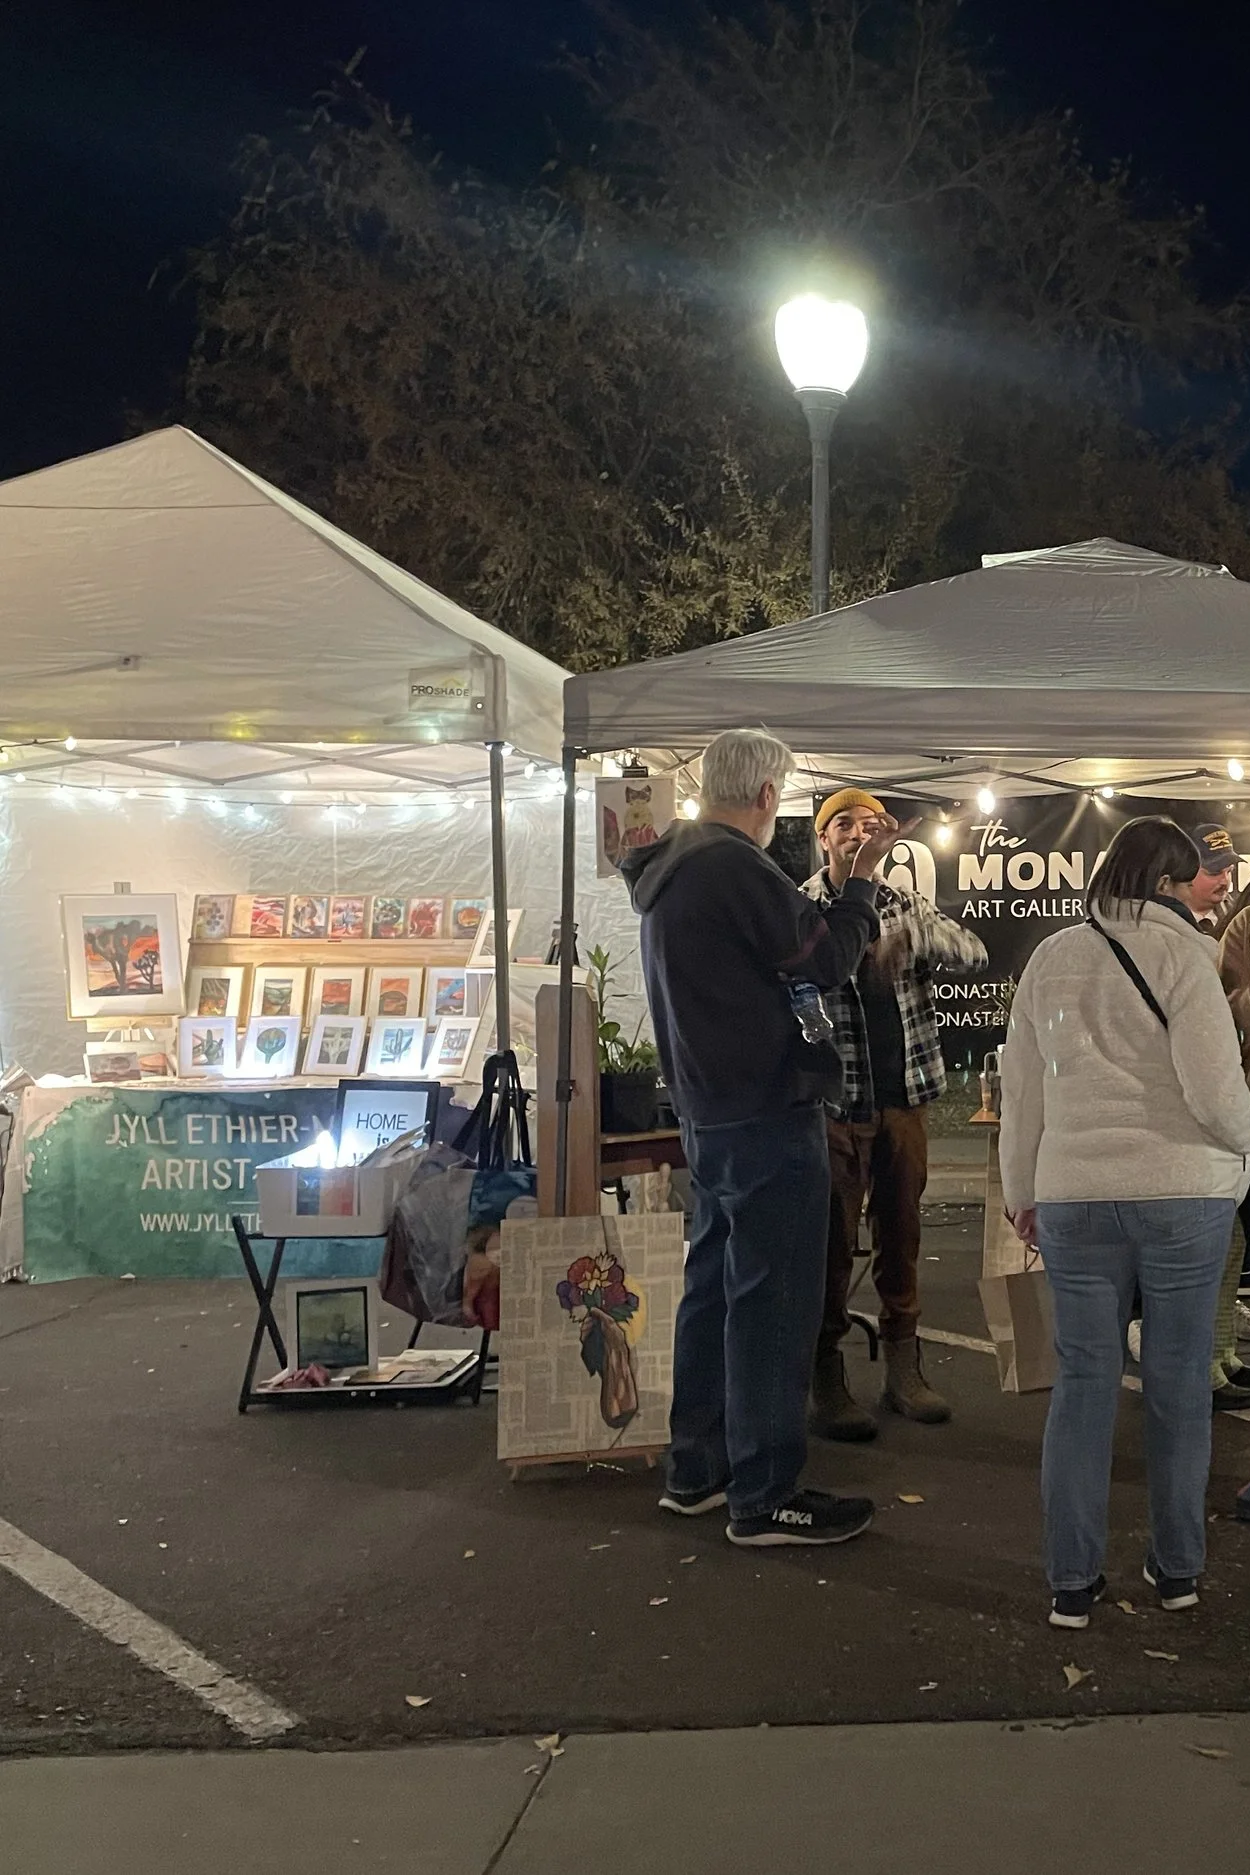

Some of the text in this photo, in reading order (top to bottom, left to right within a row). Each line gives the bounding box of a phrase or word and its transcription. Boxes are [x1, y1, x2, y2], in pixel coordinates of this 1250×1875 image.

[411, 685, 469, 697] PROSHADE
[969, 818, 1028, 857] the
[961, 899, 1088, 919] ART GALLER
[932, 983, 1018, 999] ONASTE
[105, 1113, 178, 1145] JYLL
[356, 1112, 408, 1131] HOME
[141, 1158, 252, 1191] ARTIST
[772, 1508, 812, 1526] HOKA
